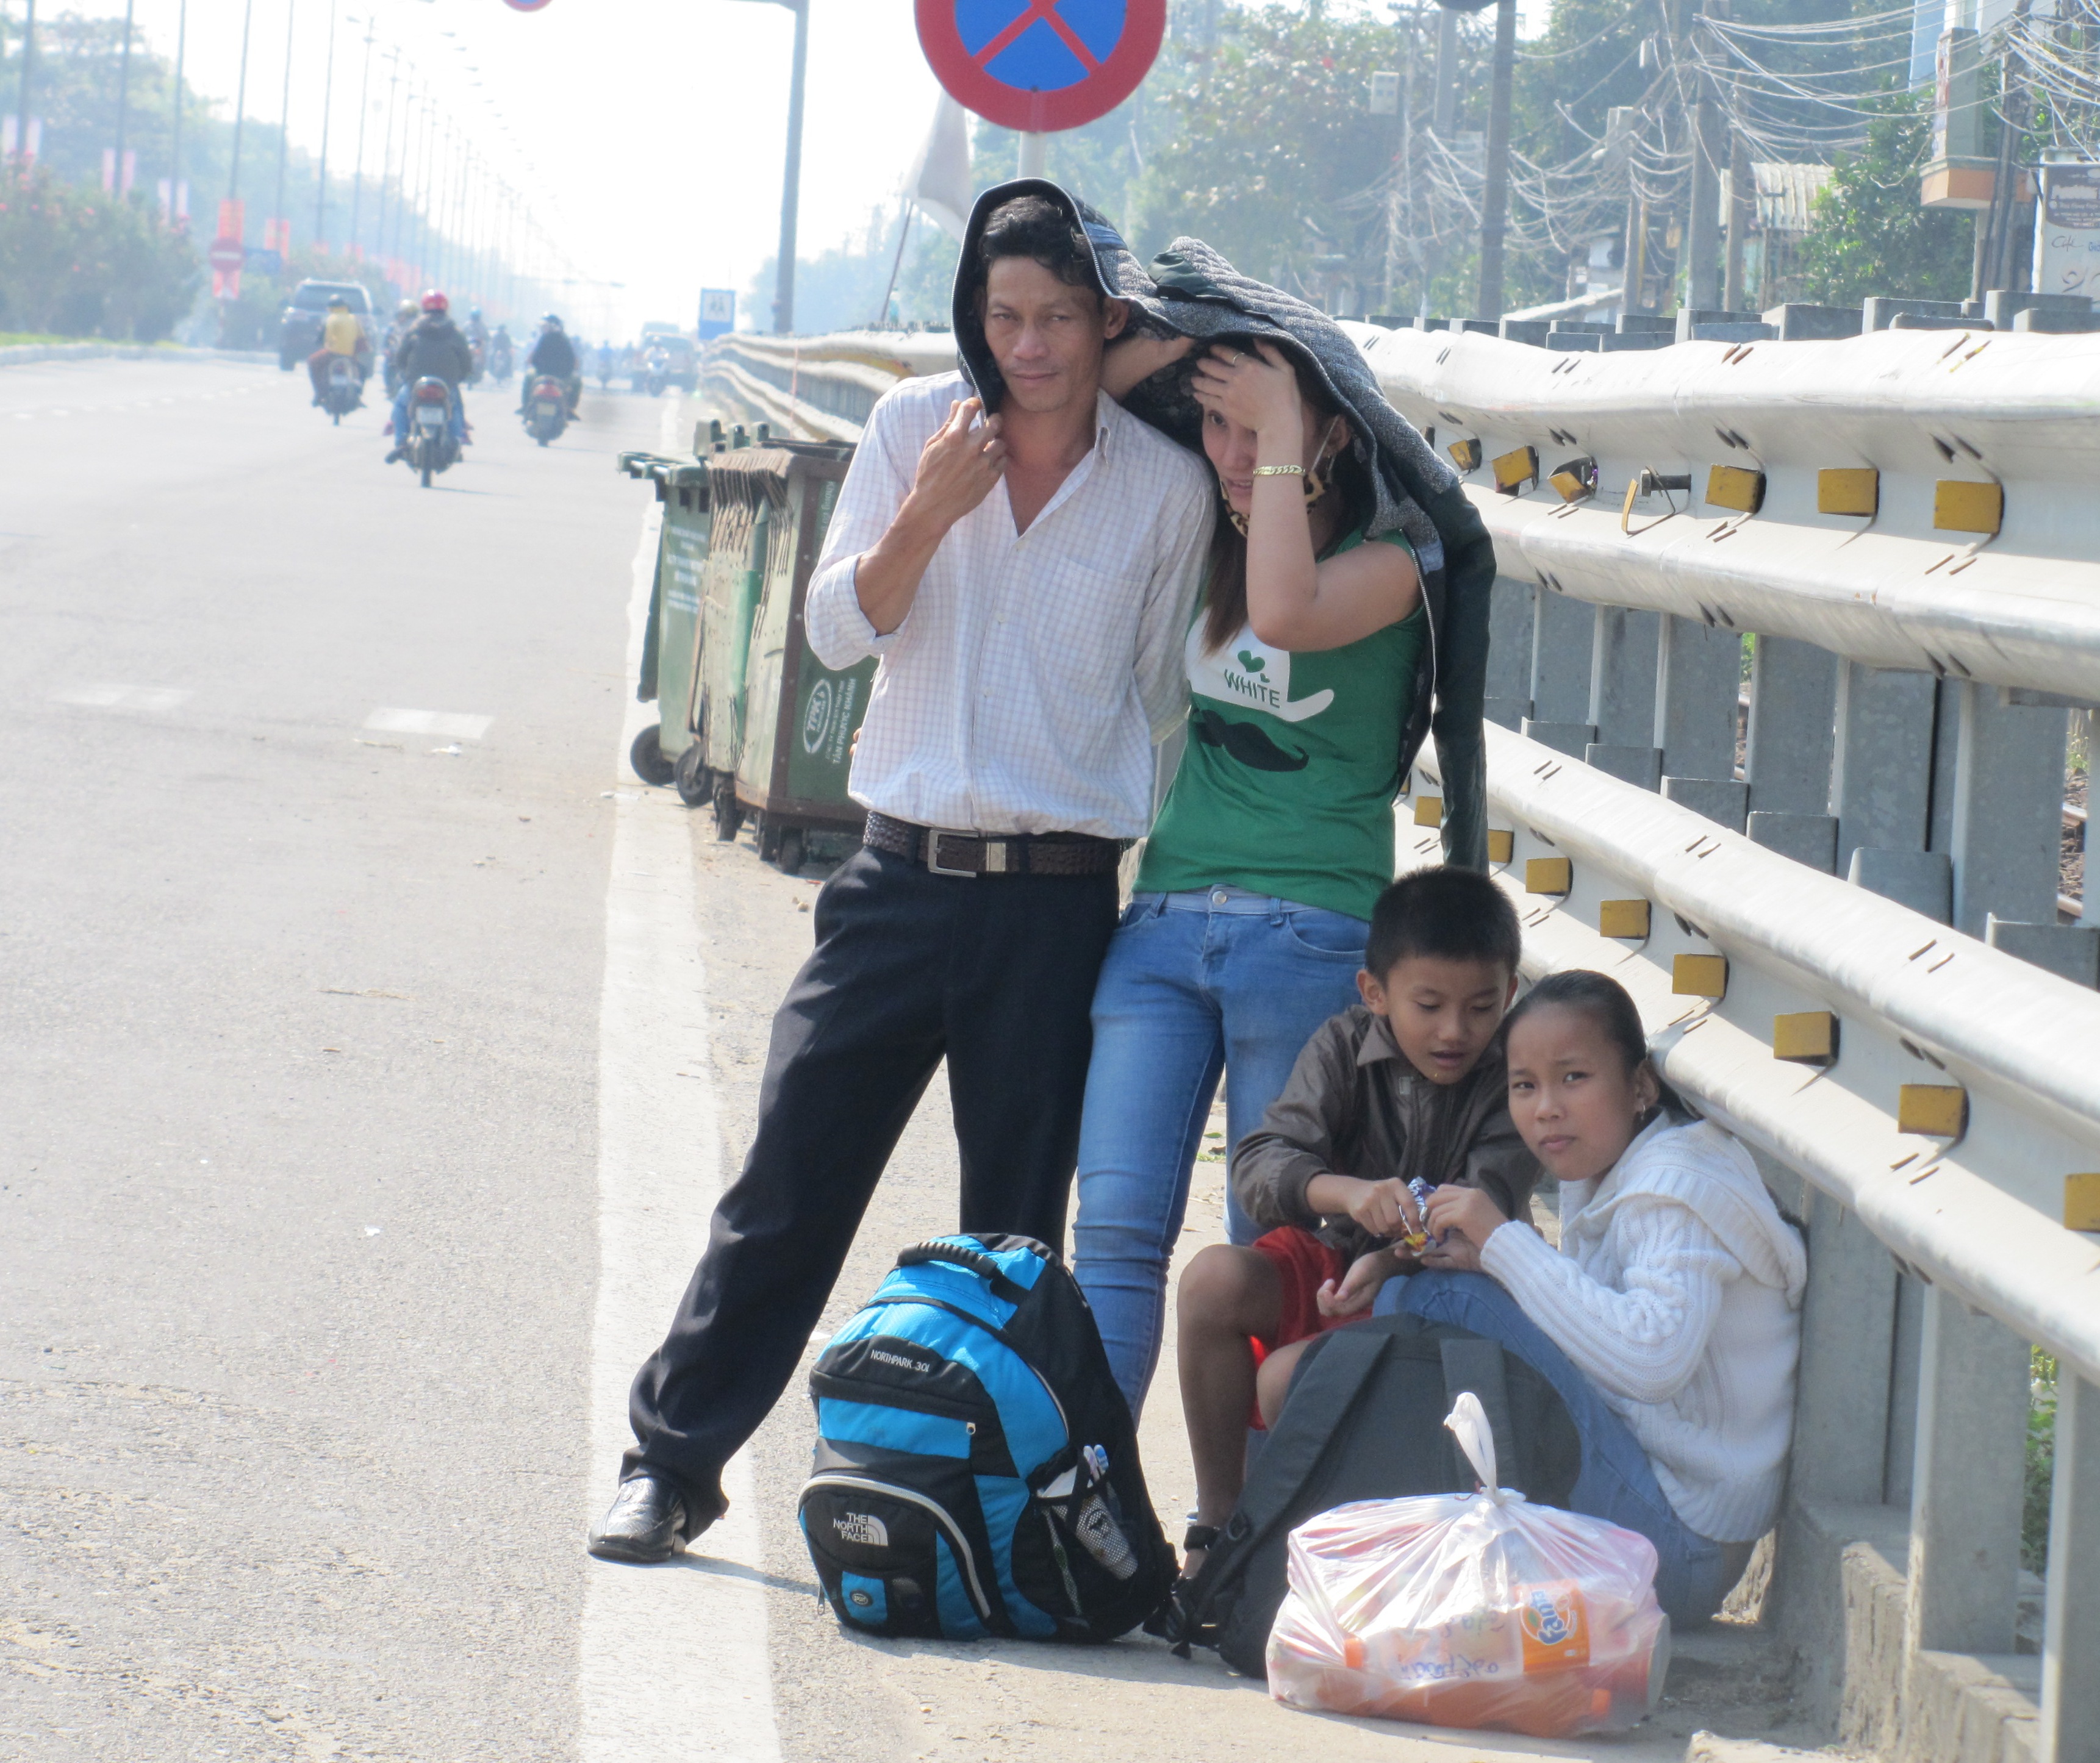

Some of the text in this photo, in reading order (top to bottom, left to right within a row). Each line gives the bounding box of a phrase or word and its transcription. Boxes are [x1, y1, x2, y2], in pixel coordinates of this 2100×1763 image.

[1224, 668, 1280, 708] WHITE
[870, 1349, 913, 1369] NORTHPARK
[833, 1517, 867, 1534] NORTH
[846, 1512, 867, 1524] THE
[841, 1529, 867, 1543] FACE
